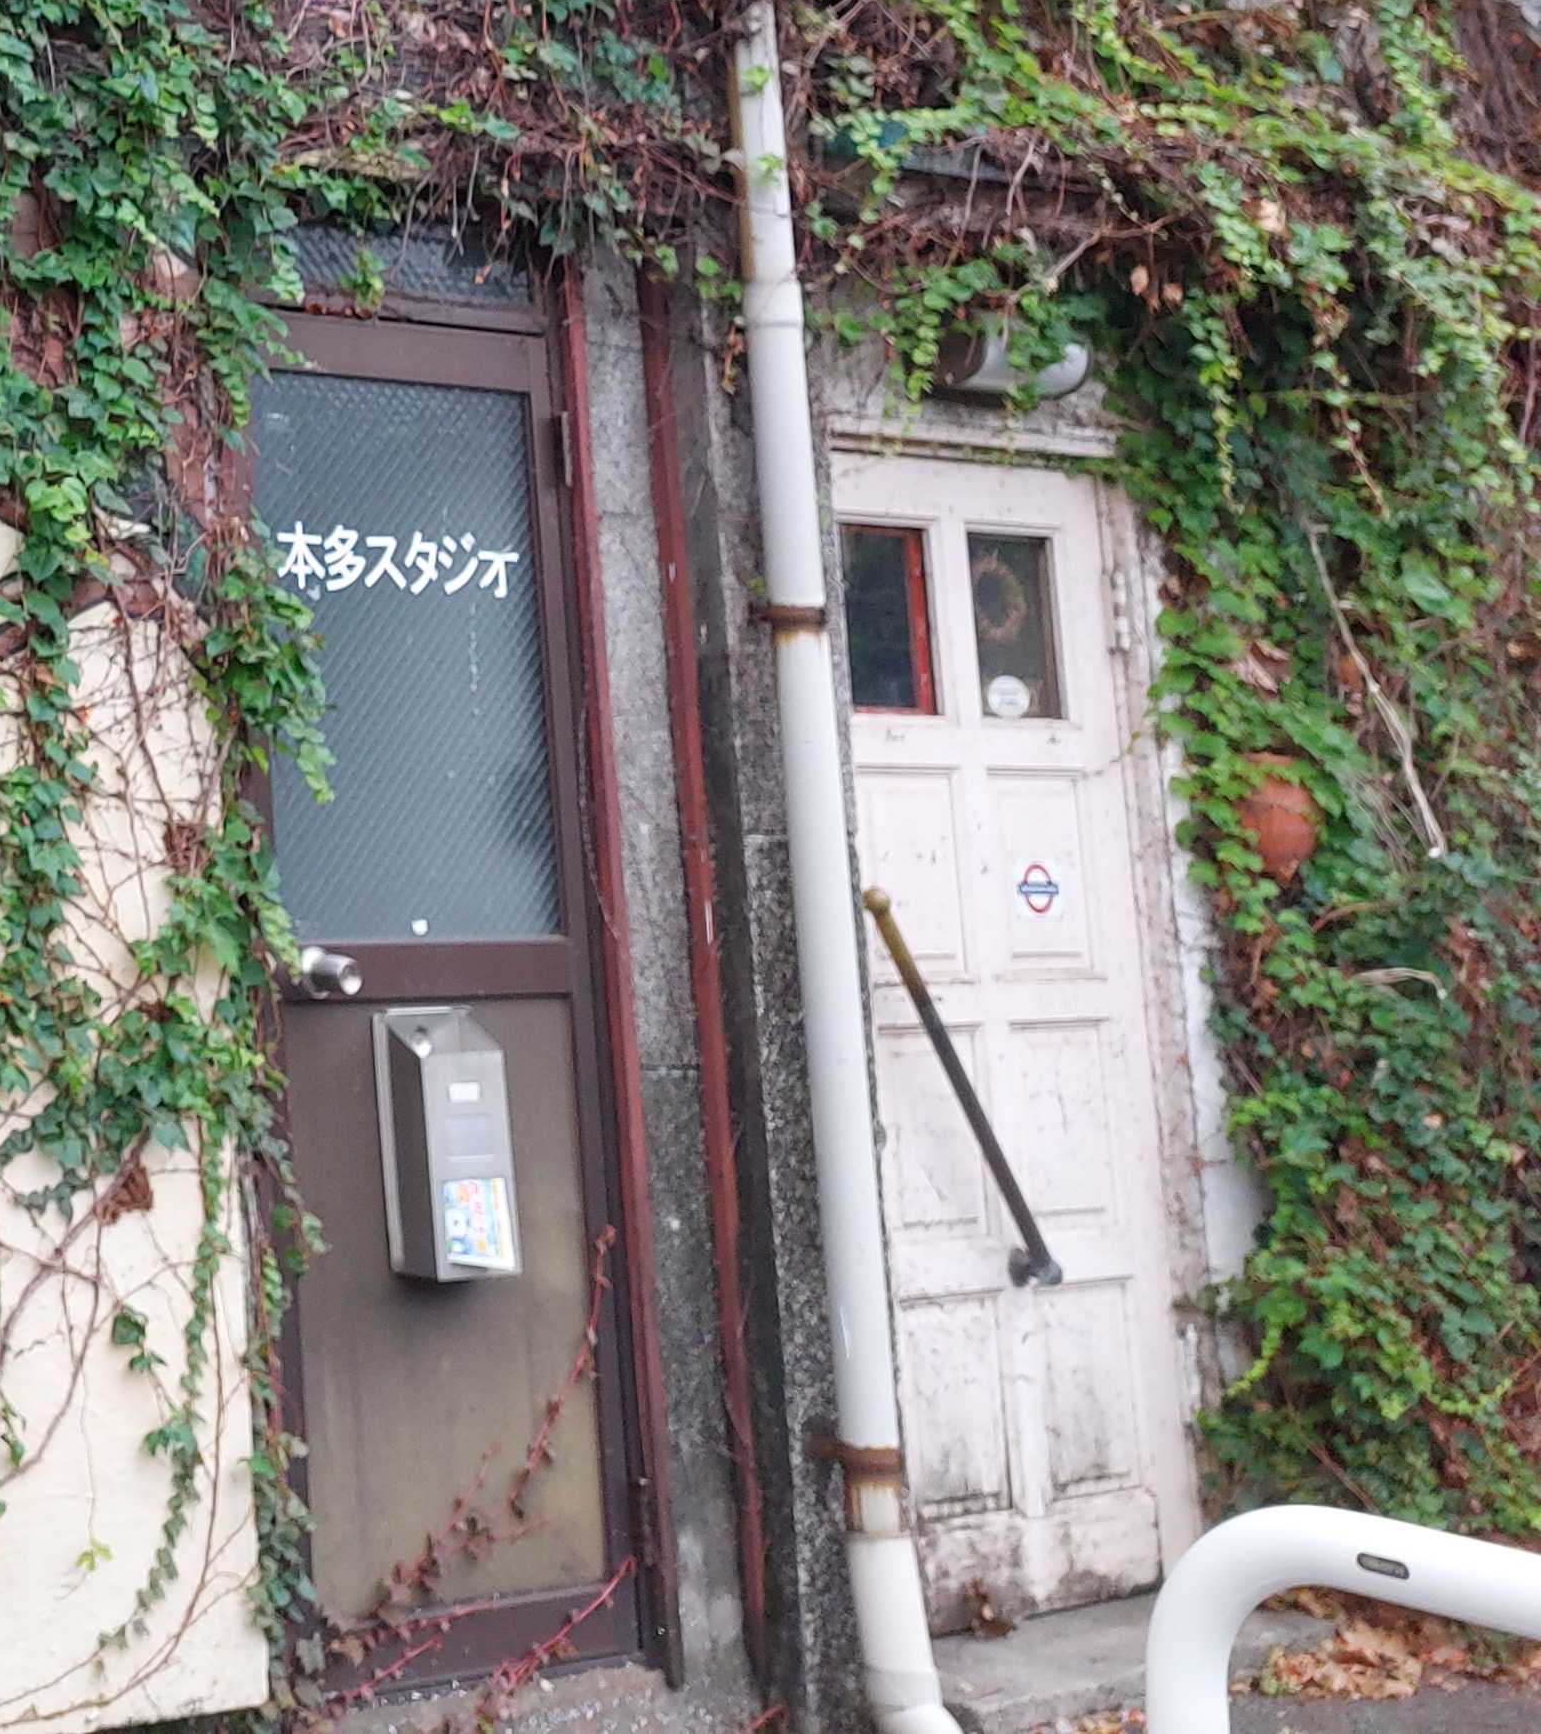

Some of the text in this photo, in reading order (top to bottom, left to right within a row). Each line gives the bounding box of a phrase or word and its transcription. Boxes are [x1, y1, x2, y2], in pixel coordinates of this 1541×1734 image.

[276, 520, 520, 599] 本多スタジオ
